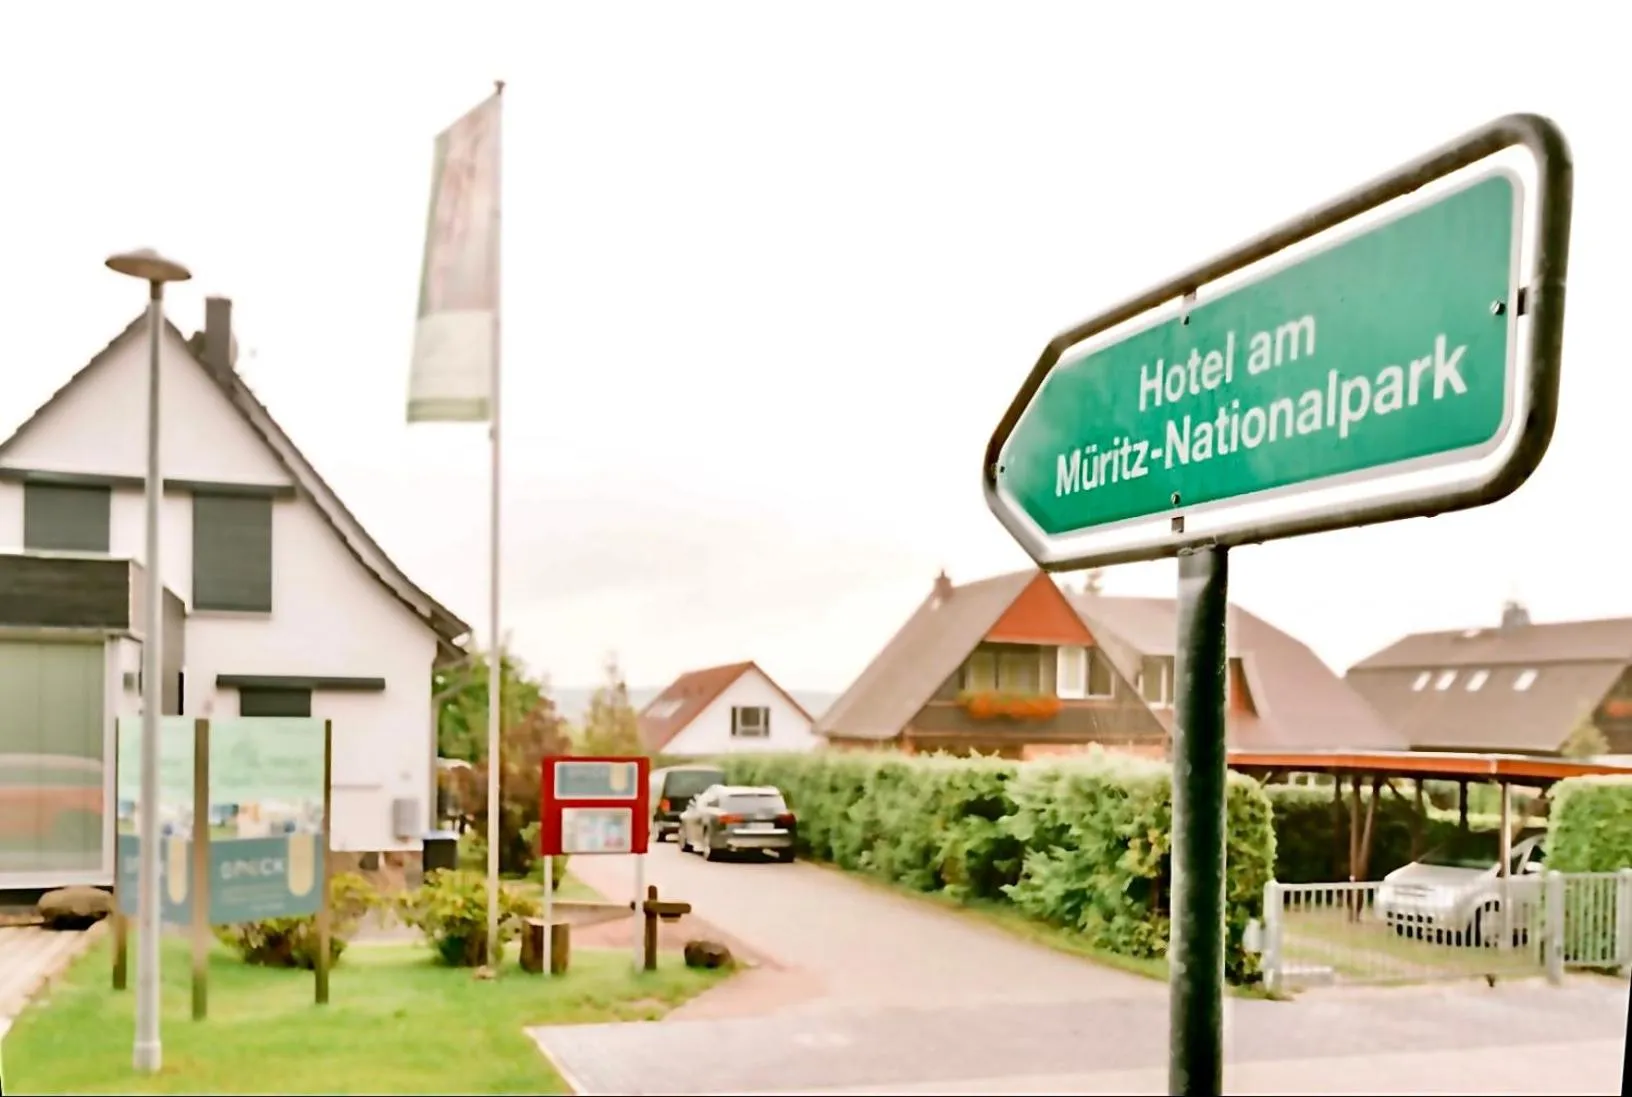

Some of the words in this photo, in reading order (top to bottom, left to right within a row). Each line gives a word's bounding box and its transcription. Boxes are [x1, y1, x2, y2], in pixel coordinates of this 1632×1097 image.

[1055, 334, 1468, 497] Müritz-Nationalpark
[1138, 332, 1234, 411] Hotel
[1247, 315, 1315, 376] am
